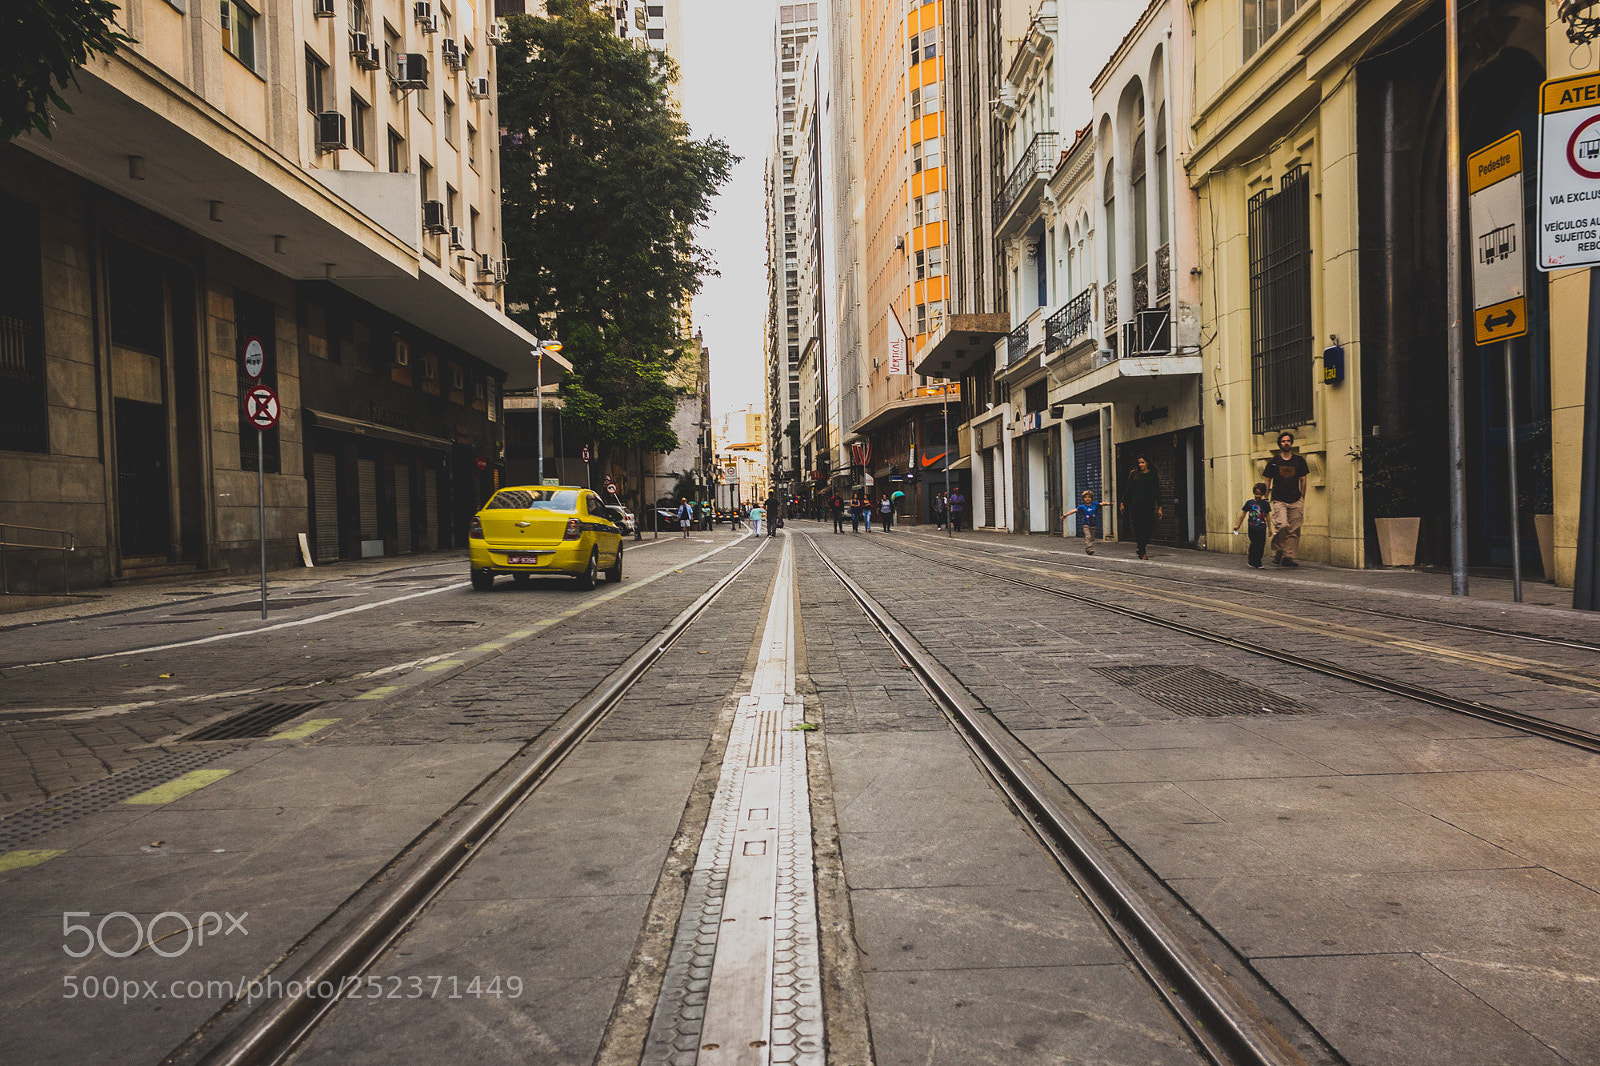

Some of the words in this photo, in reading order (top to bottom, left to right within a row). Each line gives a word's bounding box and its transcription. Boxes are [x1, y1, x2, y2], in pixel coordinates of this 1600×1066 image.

[1560, 84, 1600, 105] ATE
[1478, 154, 1511, 177] Pedestre
[1549, 195, 1565, 205] VIA
[1544, 218, 1588, 232] VEÍCULOS
[1554, 229, 1597, 243] SUJEITOS
